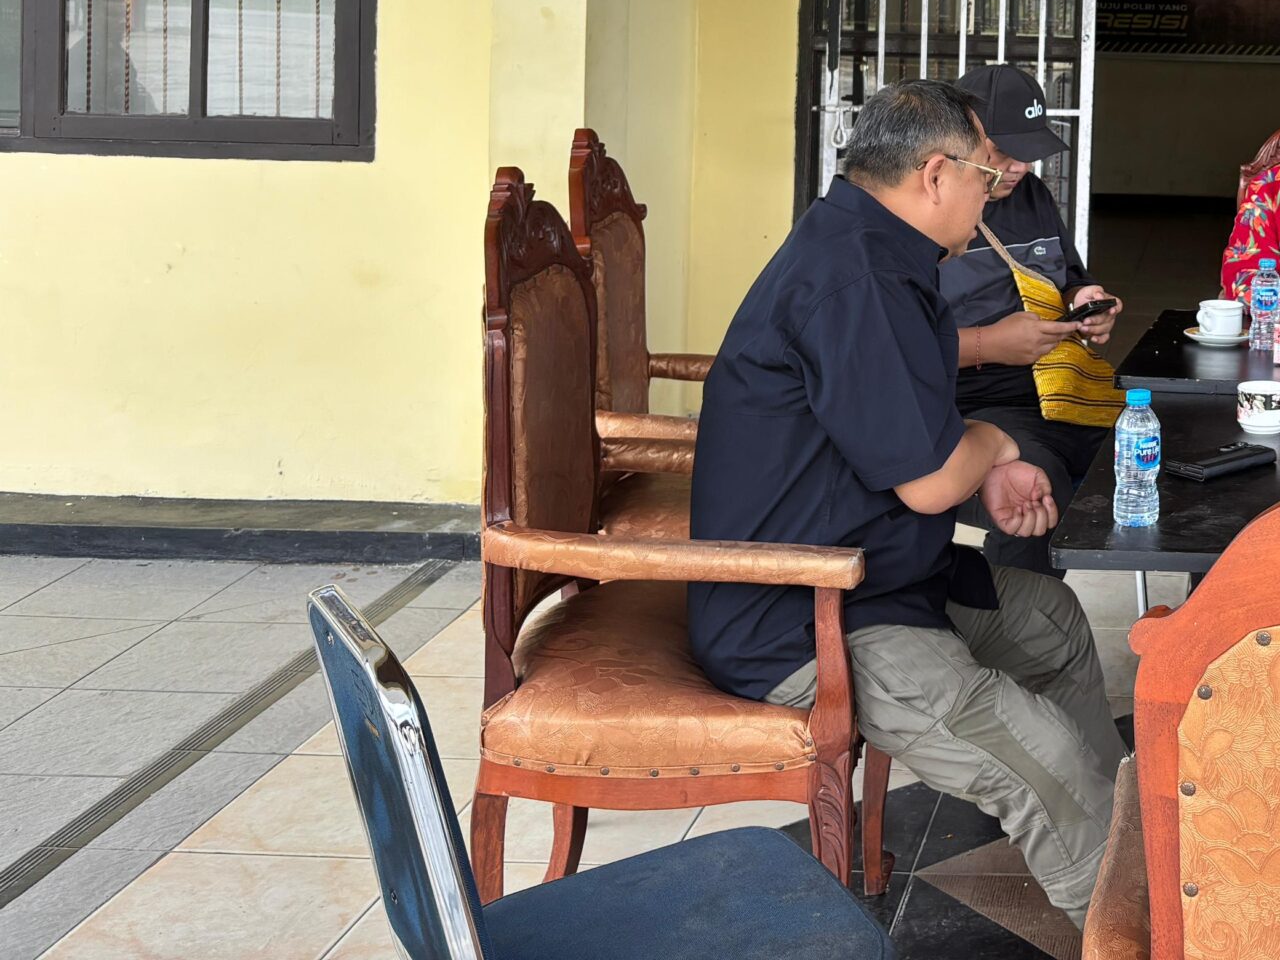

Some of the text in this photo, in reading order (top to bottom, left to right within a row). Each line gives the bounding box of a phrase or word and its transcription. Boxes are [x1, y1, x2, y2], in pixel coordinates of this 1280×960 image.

[1123, 3, 1156, 11] POLRI
[1157, 4, 1188, 12] YANG
[1025, 98, 1043, 119] alo
[1135, 448, 1152, 456] Pure
